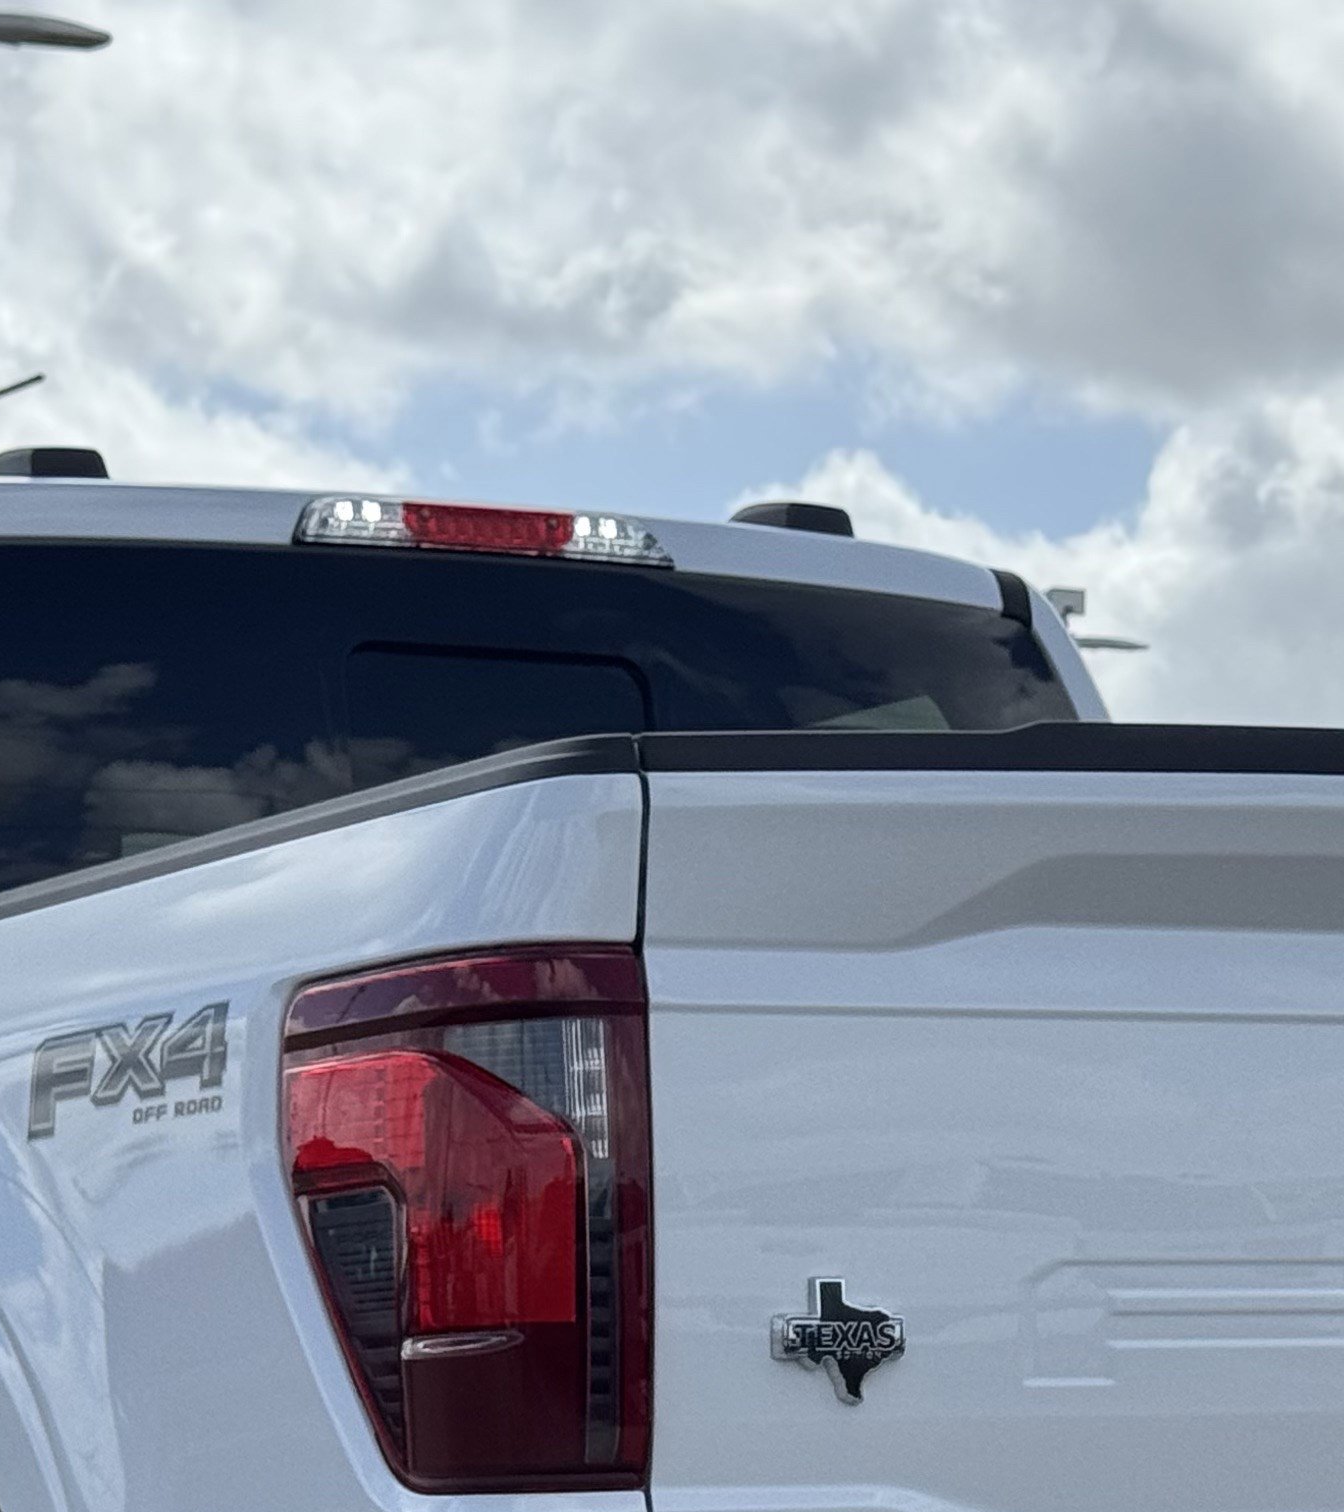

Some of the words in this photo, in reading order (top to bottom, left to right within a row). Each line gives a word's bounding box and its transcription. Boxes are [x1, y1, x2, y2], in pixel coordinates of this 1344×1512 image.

[28, 1000, 230, 1141] FX4
[132, 1103, 168, 1125] OFF
[174, 1096, 222, 1118] ROAD
[792, 1320, 898, 1350] TEXAS
